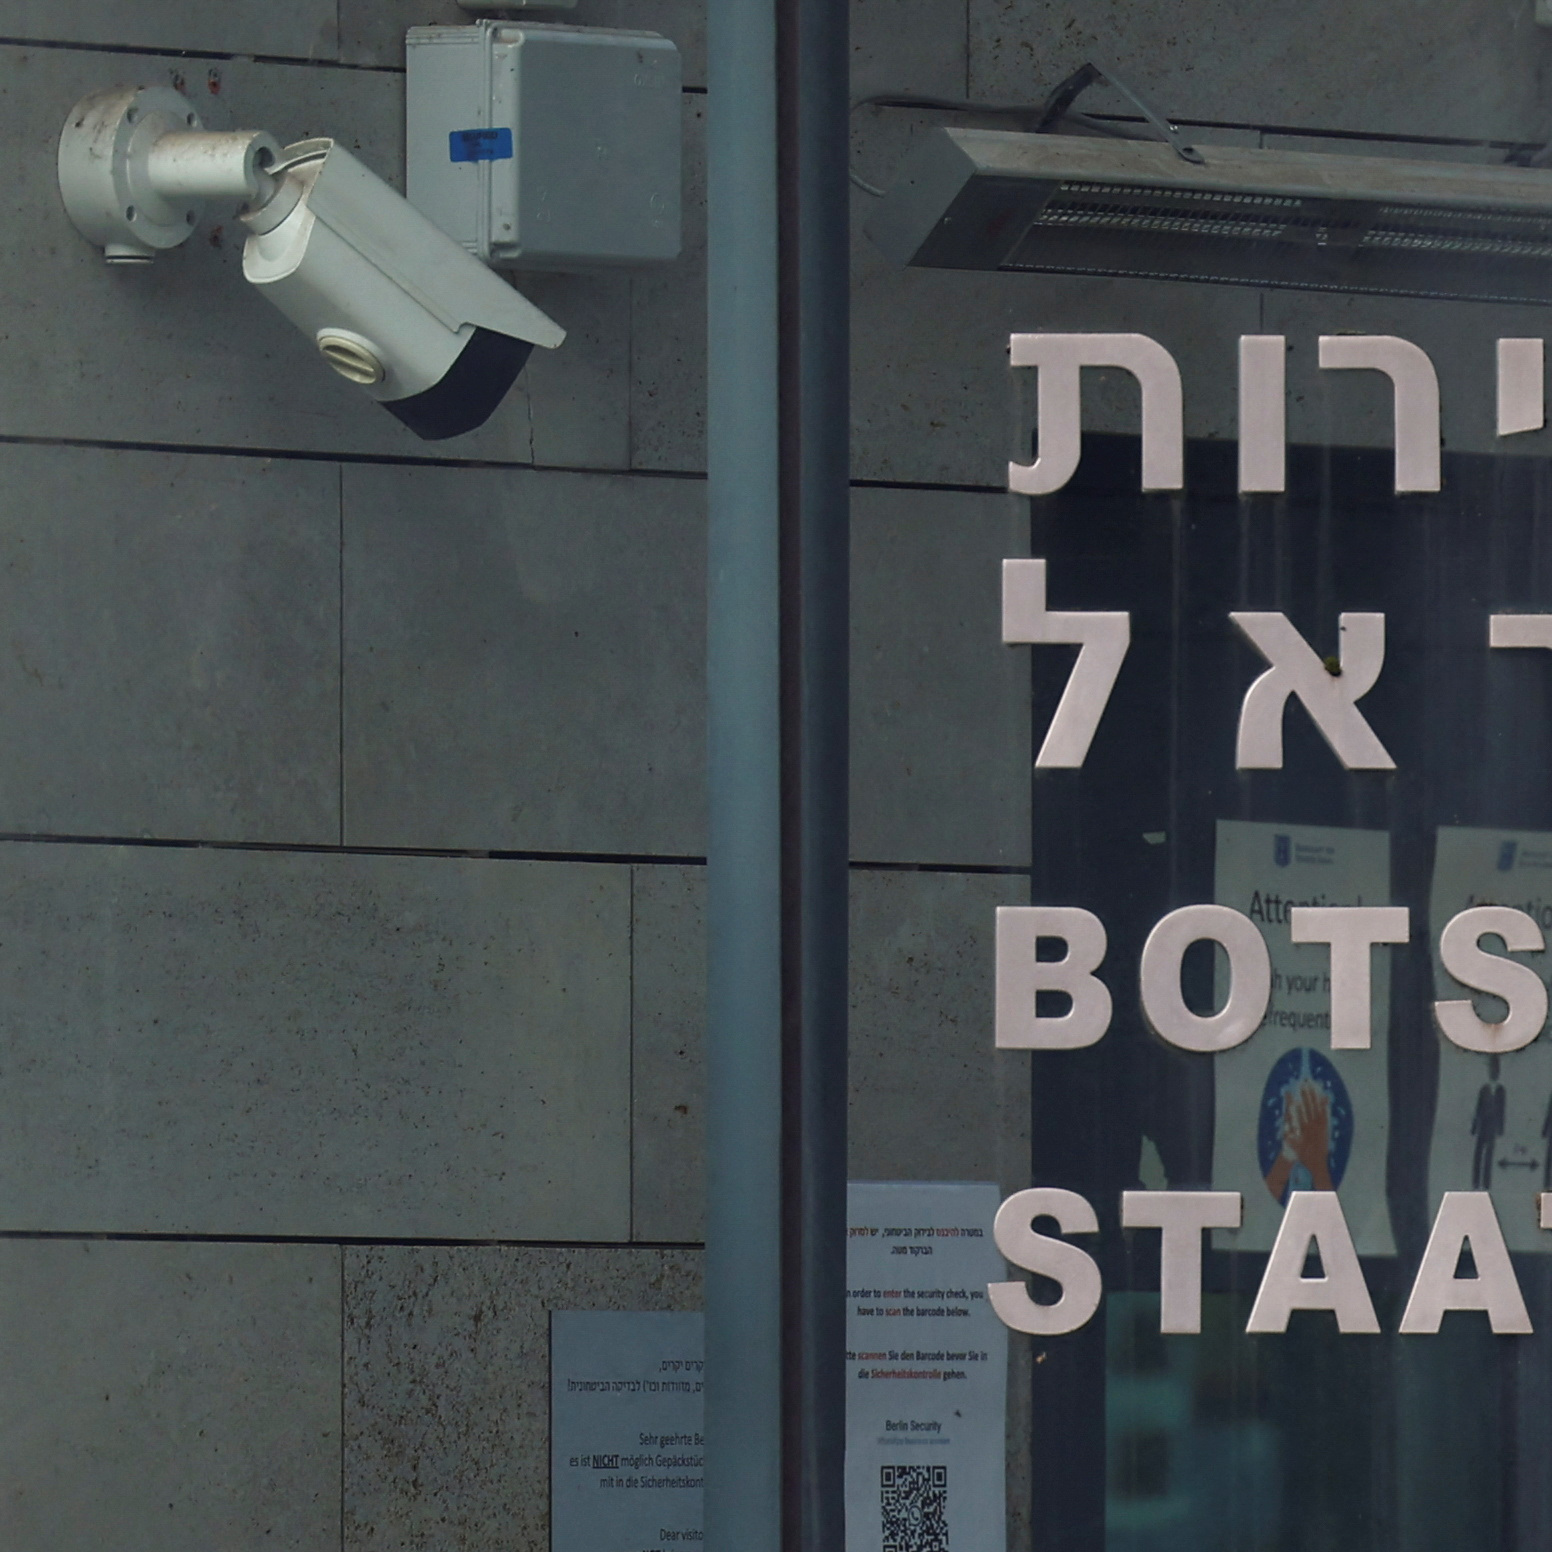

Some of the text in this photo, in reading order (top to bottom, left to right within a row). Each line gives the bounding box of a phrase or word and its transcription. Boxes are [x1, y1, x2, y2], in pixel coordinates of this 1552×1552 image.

[853, 1289, 872, 1298] order
[874, 1289, 881, 1298] to
[883, 1290, 902, 1298] enter
[904, 1288, 915, 1298] the
[917, 1289, 944, 1300] security
[946, 1288, 969, 1300] check,
[970, 1292, 983, 1300] you
[858, 1306, 971, 1316] have to scan the barcode below.
[858, 1352, 887, 1360] scannen
[888, 1350, 899, 1360] Sie
[901, 1350, 915, 1360] den
[916, 1350, 944, 1360] Barcode
[946, 1350, 967, 1360] bevor
[968, 1350, 979, 1360] Sie
[981, 1351, 988, 1360] in
[858, 1369, 967, 1381] die Sicherheitskontrolle gehen.
[886, 1420, 942, 1434] Berlin Security
[639, 1433, 658, 1446] Sehr
[660, 1434, 693, 1448] geehrte
[569, 1454, 704, 1469] es ist NICHT möglich Gepäckstüc
[600, 1475, 704, 1489] mit in die Sicherheitskont
[659, 1528, 704, 1541] Dear visito
